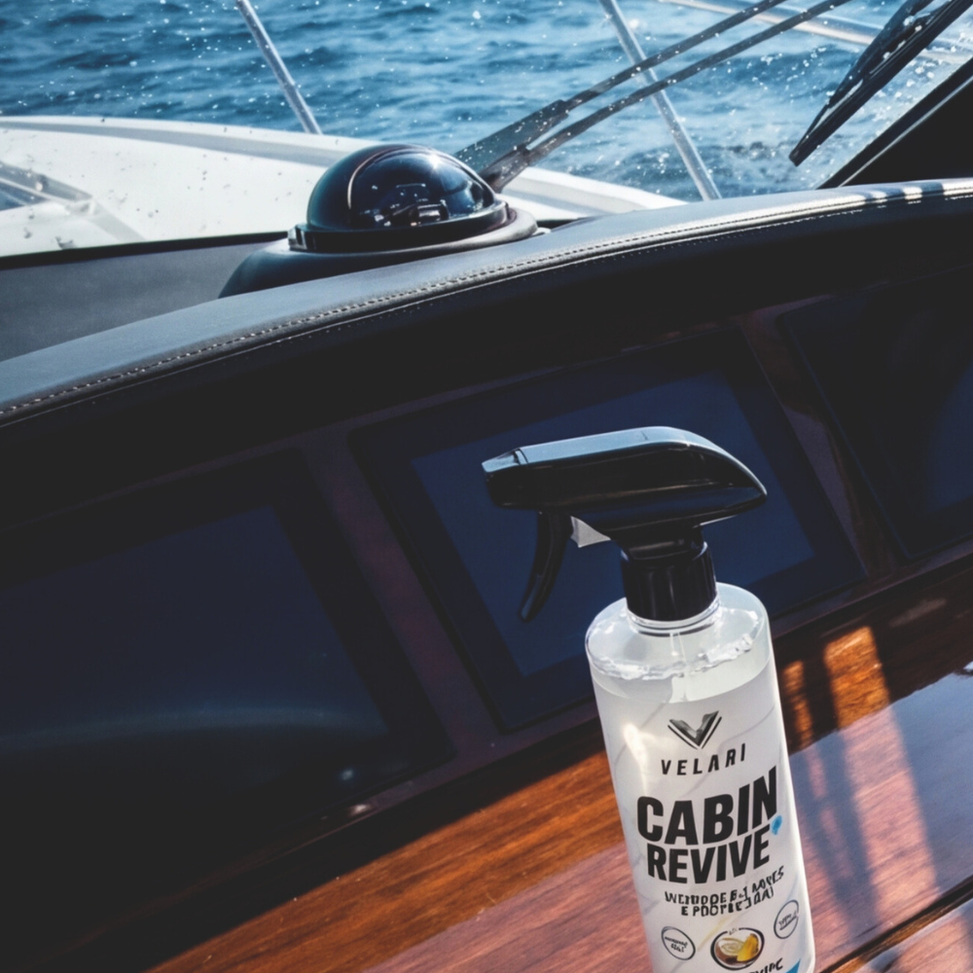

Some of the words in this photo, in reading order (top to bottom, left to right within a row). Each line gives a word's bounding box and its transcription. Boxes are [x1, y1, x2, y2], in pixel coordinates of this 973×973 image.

[660, 743, 746, 776] VELARI
[637, 765, 778, 845] CABIN
[647, 823, 771, 884] REVIVE
